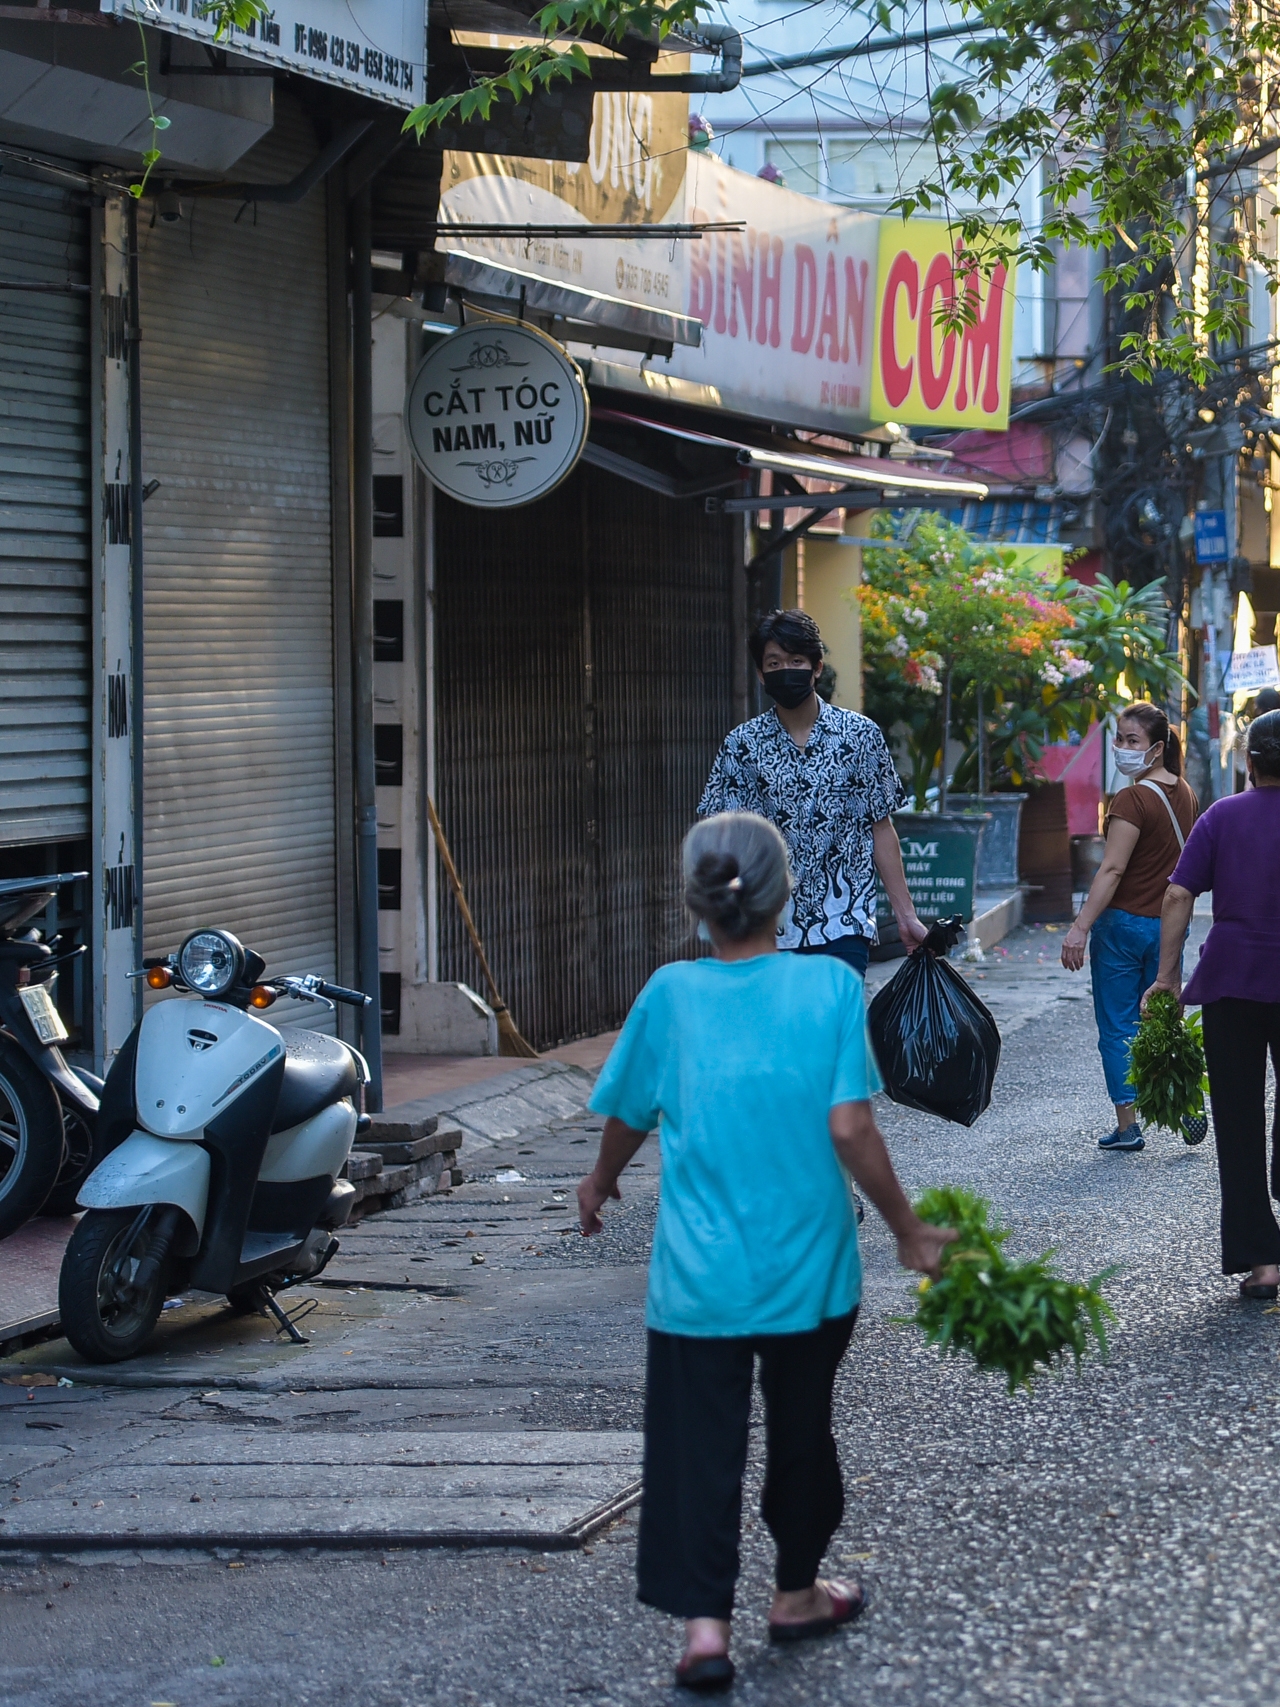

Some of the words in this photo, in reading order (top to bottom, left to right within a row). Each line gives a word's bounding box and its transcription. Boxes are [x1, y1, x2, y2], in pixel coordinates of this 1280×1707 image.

[790, 217, 871, 367] DÂN
[878, 236, 1008, 414] CƠM
[424, 378, 486, 417] CẮT
[495, 376, 561, 412] TÓC
[432, 423, 506, 453] NAM,
[514, 412, 556, 447] NỮ
[108, 658, 128, 739] HÓA
[906, 861, 932, 873] MÁY
[203, 1003, 228, 1013] HONDA
[238, 1058, 267, 1084] TODAY
